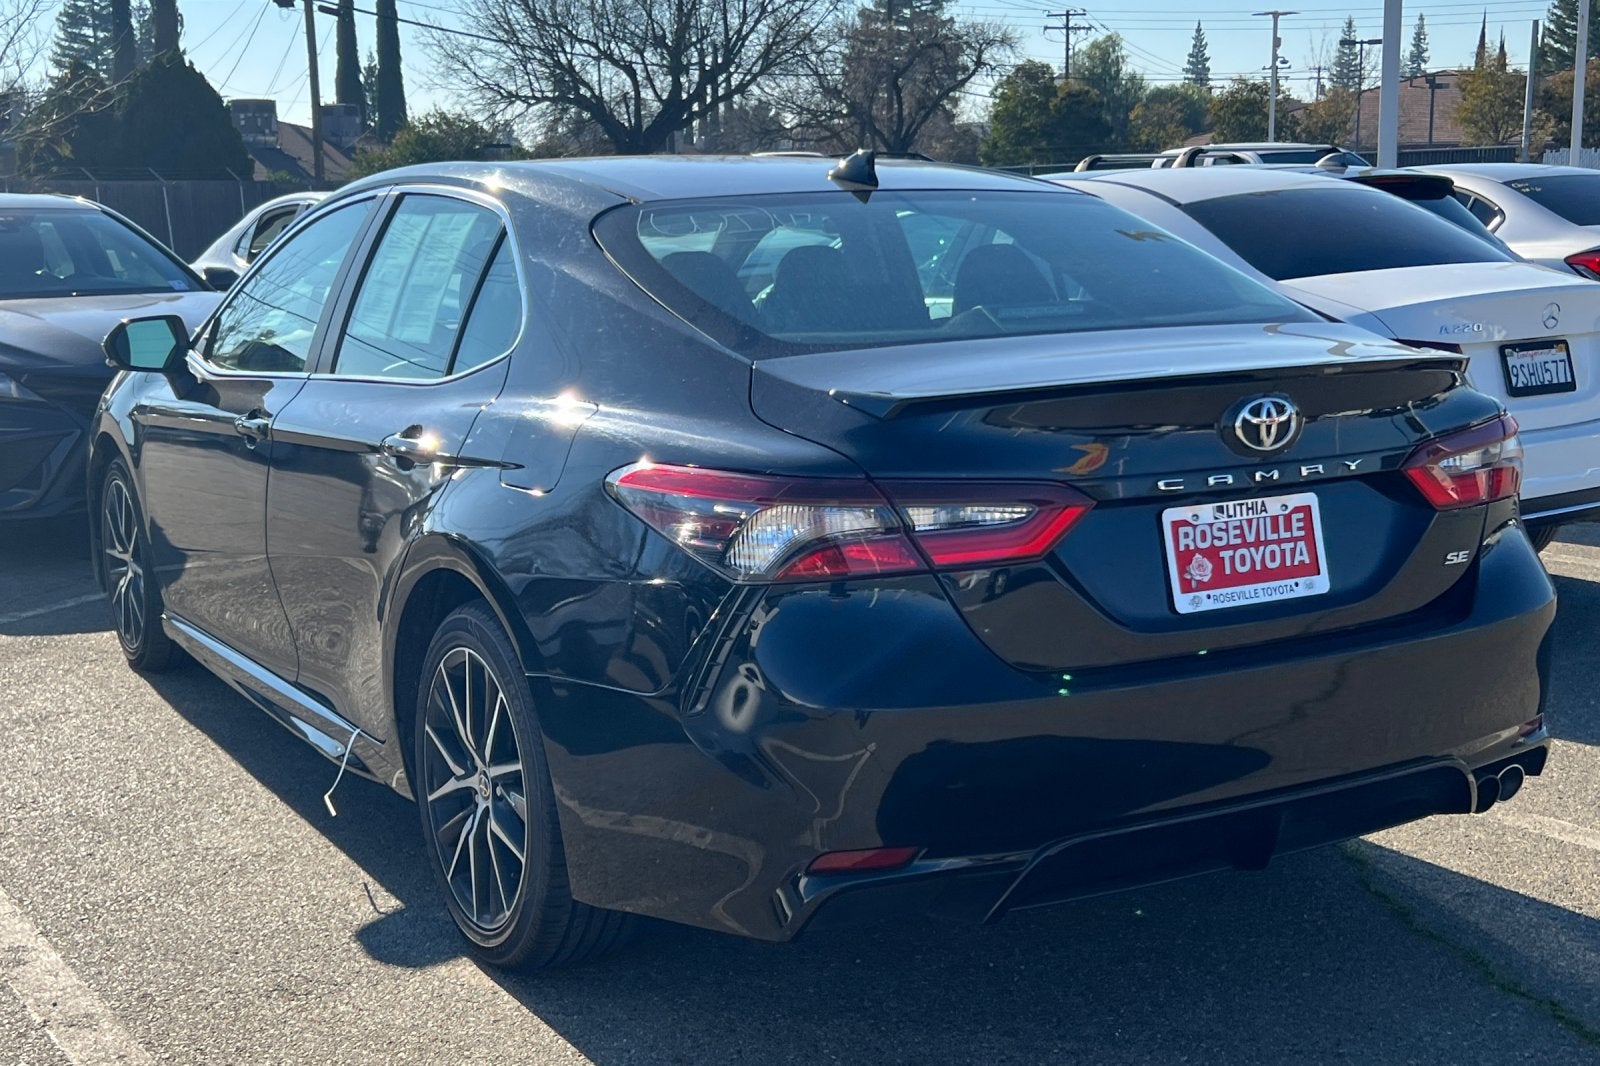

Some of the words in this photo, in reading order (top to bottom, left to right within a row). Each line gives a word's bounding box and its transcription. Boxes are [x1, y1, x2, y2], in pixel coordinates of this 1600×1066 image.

[1511, 359, 1569, 387] 9SHU577
[1157, 458, 1364, 491] CAMRY
[1225, 500, 1268, 519] LITHIA
[1178, 512, 1306, 552] ROSEVILLE
[1219, 541, 1311, 575] TOYOTA
[1444, 550, 1470, 565] SE
[1212, 588, 1260, 604] ROSEVILLE
[1262, 584, 1295, 599] TOYOTA
